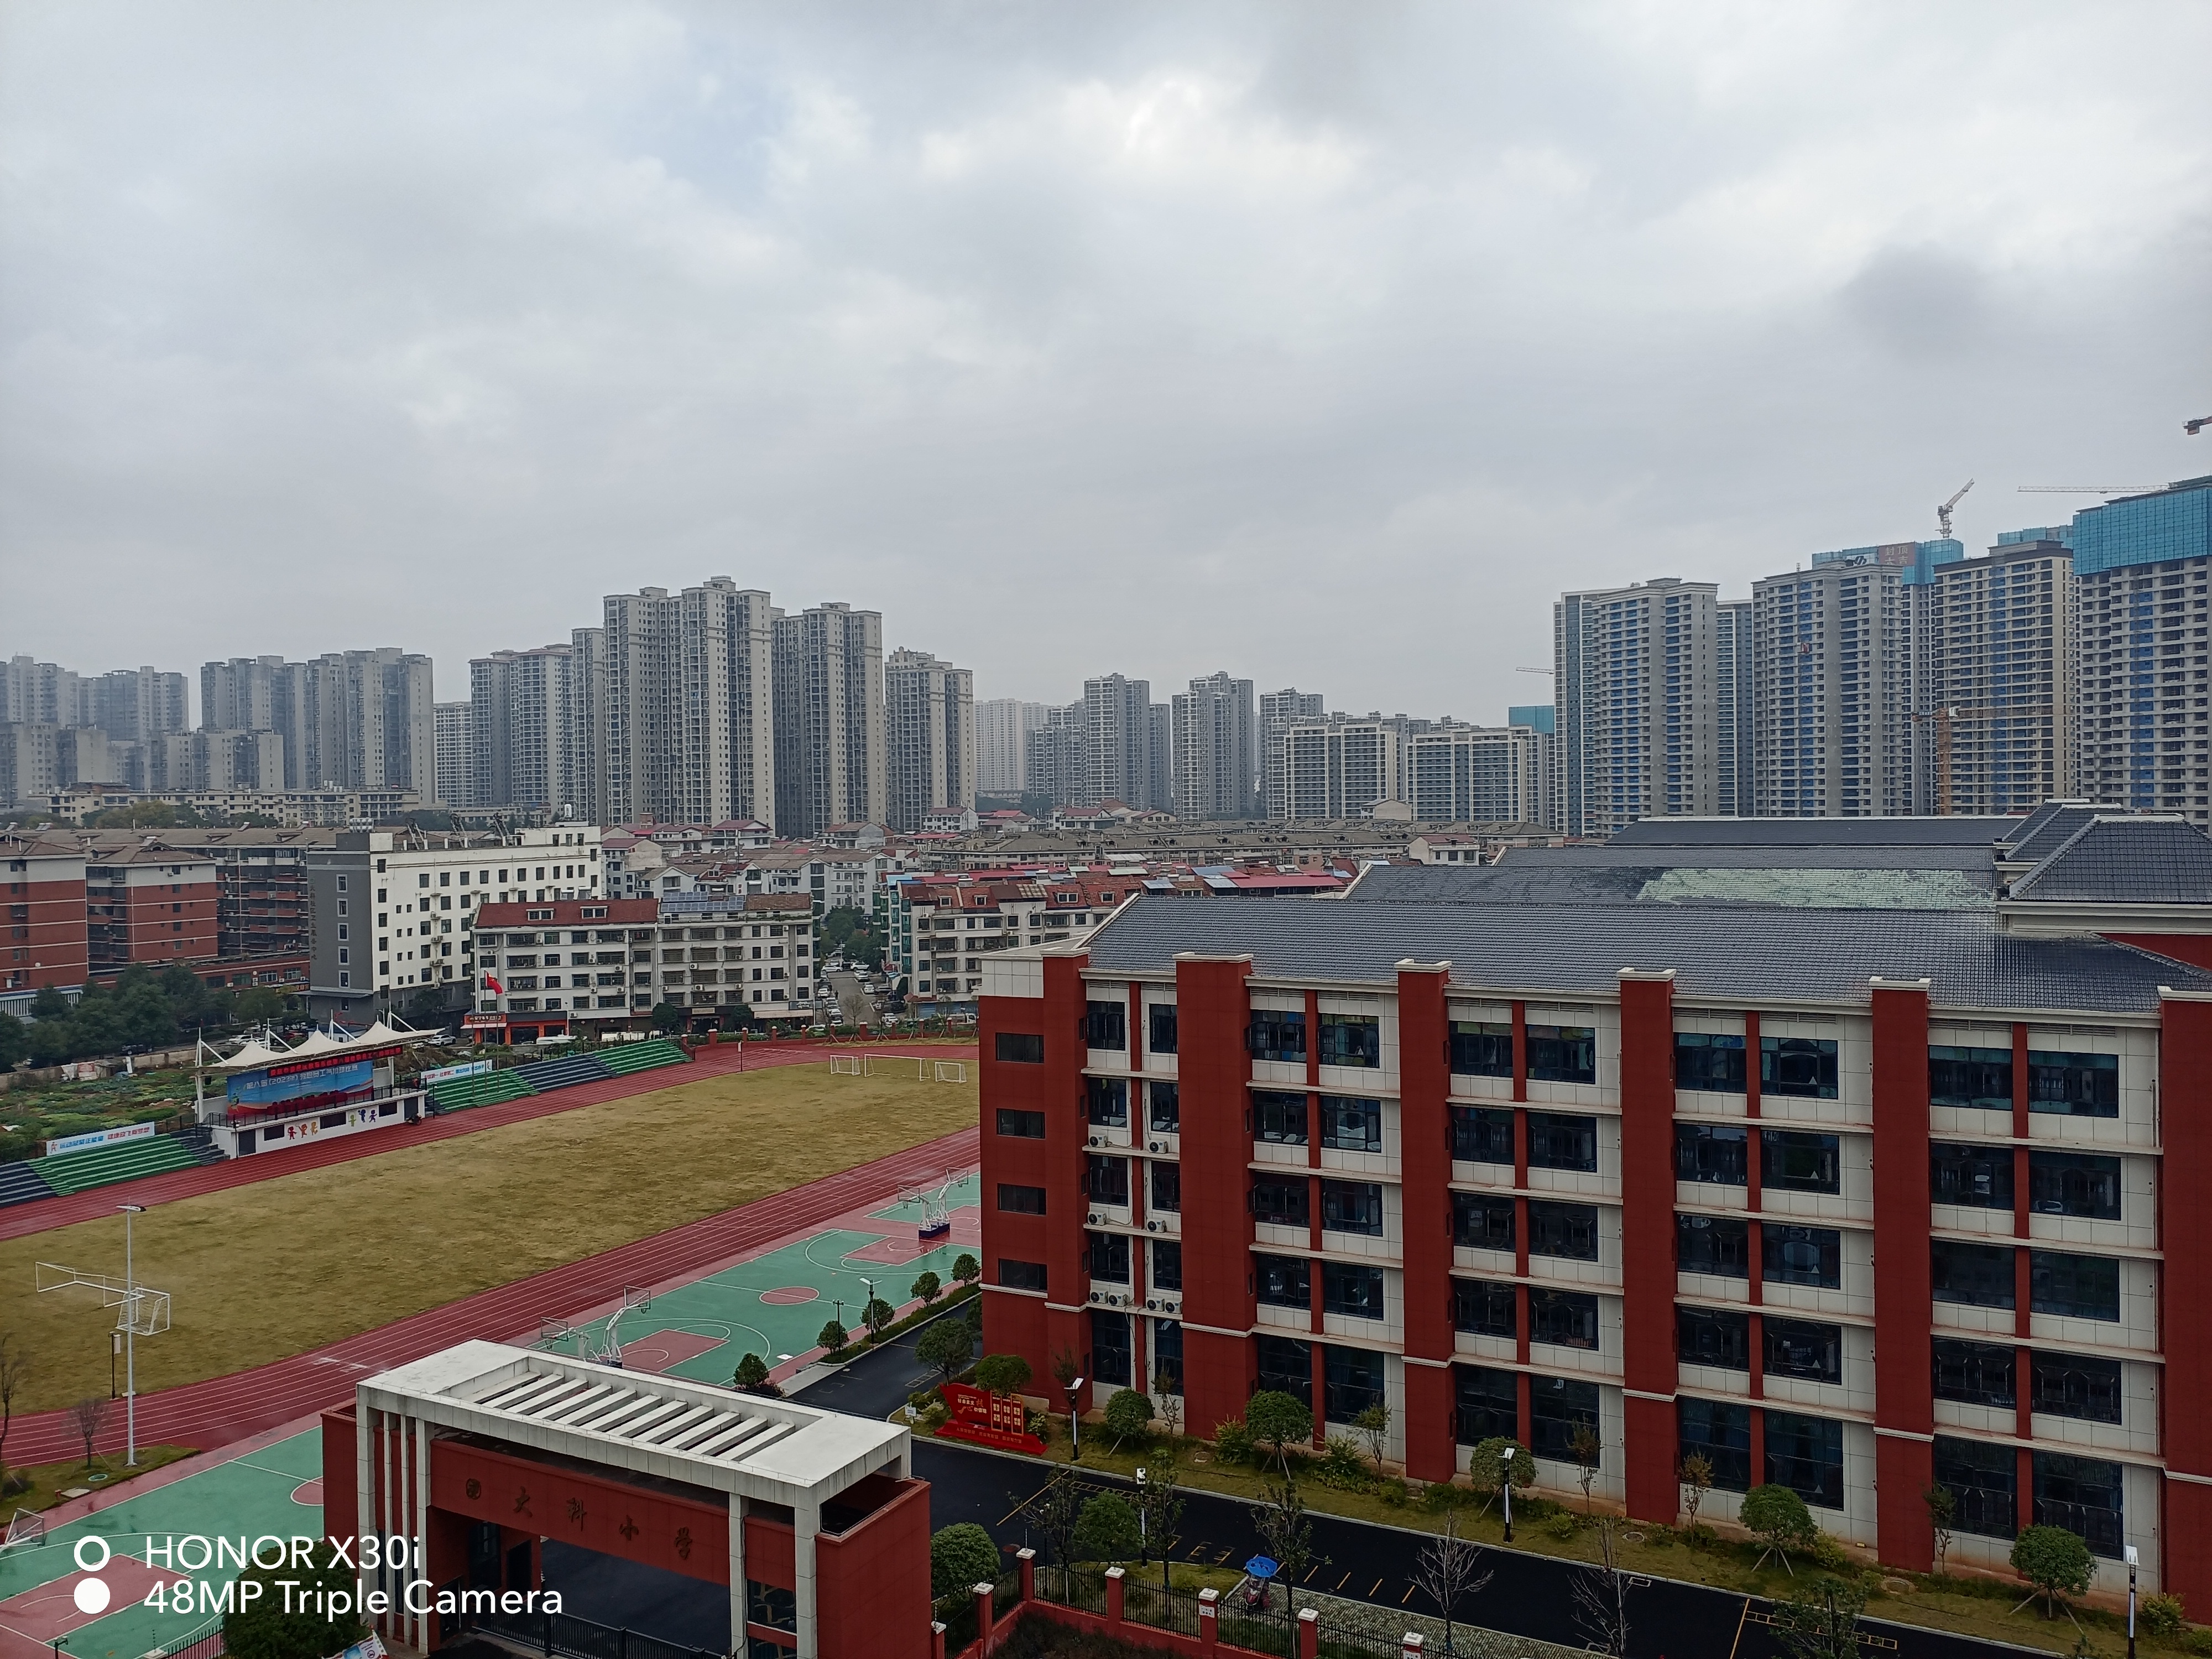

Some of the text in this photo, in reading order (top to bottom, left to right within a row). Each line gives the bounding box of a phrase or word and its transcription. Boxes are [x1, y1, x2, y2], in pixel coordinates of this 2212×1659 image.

[1885, 545, 1908, 556] 封顶
[513, 1486, 693, 1559] 大科小学
